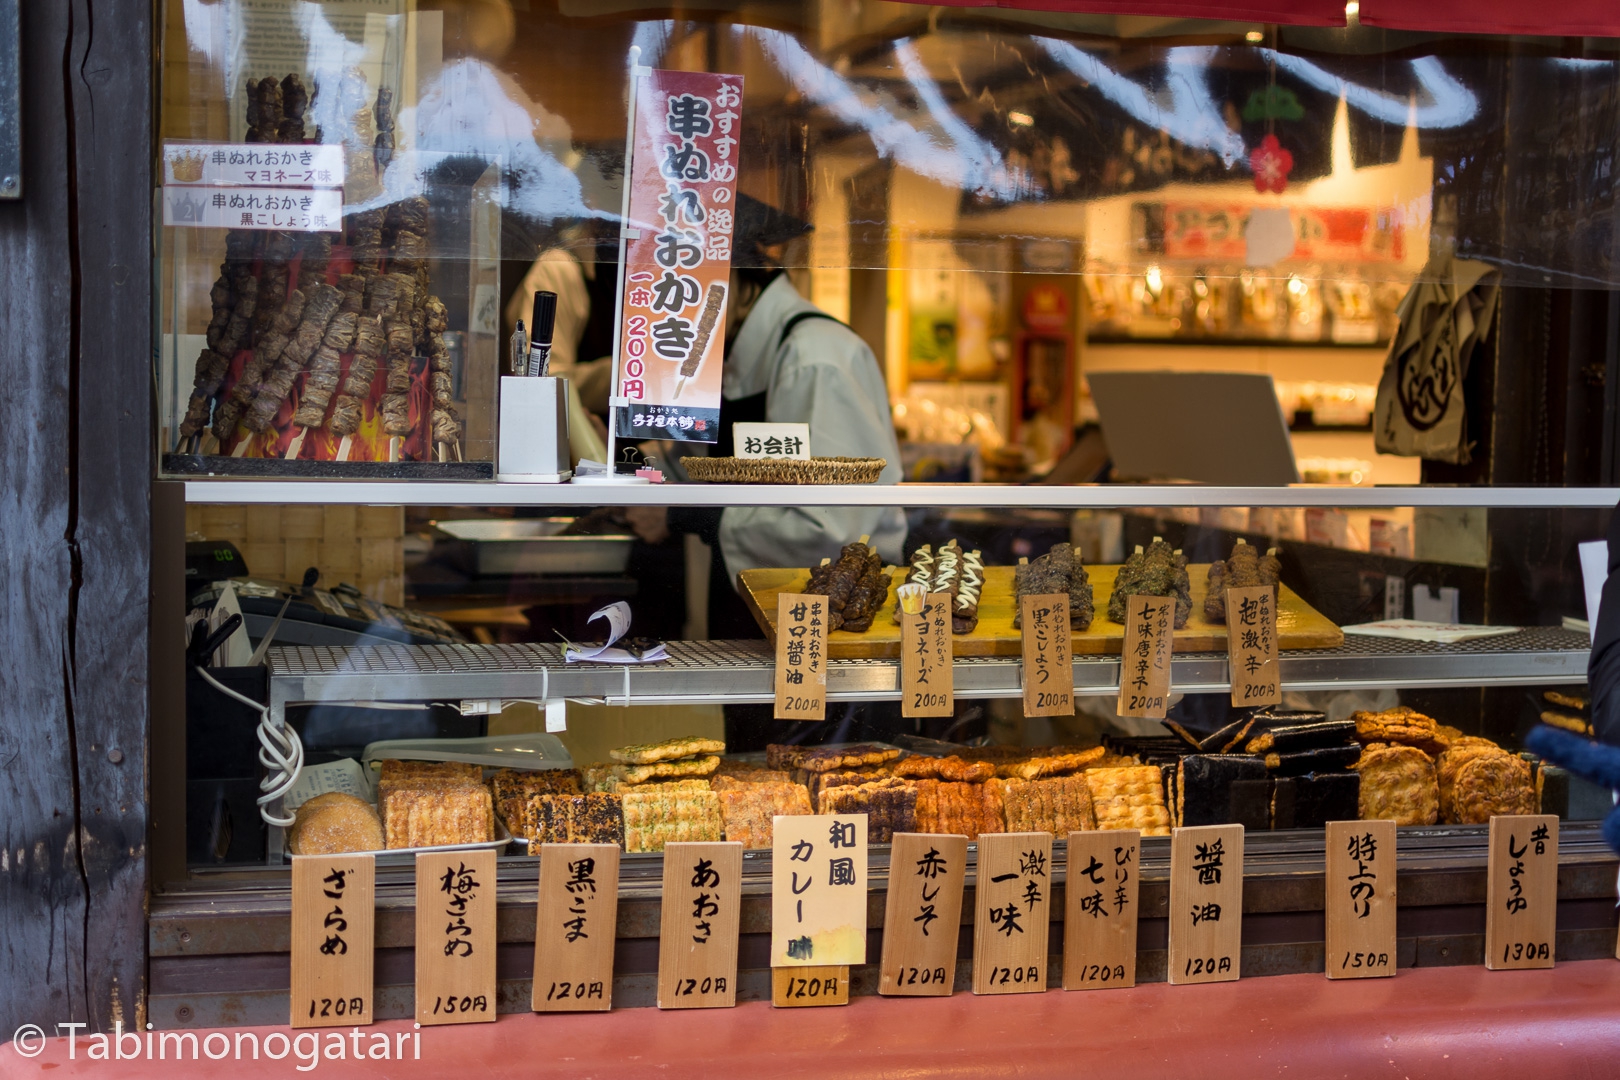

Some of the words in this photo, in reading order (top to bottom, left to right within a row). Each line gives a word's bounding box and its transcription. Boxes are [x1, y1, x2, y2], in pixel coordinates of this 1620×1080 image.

[212, 150, 313, 166] 串ぬれおかき
[244, 169, 332, 183] マヨネーズ味
[706, 82, 740, 260] おすすめの逸品
[212, 193, 313, 211] 串ぬれおかき
[240, 212, 328, 227] 黒こしょう味
[652, 95, 712, 358] 串ぬれおかき
[744, 436, 803, 455] お会計
[785, 602, 808, 685] 甘口醤油
[808, 601, 822, 673] 串ぬれおかき
[934, 602, 947, 667] 串ぬれおかき
[1032, 608, 1051, 684] 黒こしょう
[1052, 603, 1066, 667] 串ぬれおかき
[1132, 602, 1156, 690] 七味唐辛子
[1154, 604, 1170, 669] 串ぬれおかき
[1238, 597, 1262, 675] 超激辛
[1259, 594, 1272, 655] 串ぬれおかき
[784, 696, 820, 711] 200円
[914, 693, 947, 709] 200円
[1036, 692, 1069, 708] 200円
[1129, 695, 1163, 710] 200円
[1244, 683, 1275, 699] 200円
[828, 820, 856, 886] 和風
[1530, 823, 1550, 855] 昔
[563, 857, 597, 943] 黒ごま
[691, 857, 720, 944] あおさ
[914, 847, 947, 936] 赤しそ
[989, 872, 1024, 937] 一味
[1018, 849, 1046, 912] 激辛
[1080, 855, 1109, 918] 七味
[1190, 838, 1225, 927] 醤油
[1347, 832, 1377, 919] 特上のり
[1506, 834, 1528, 915] しょうゆ
[320, 867, 354, 956] ざらめ
[440, 862, 480, 957] 梅ざらめ
[897, 967, 946, 986] 120円
[990, 966, 1038, 985] 120円
[1080, 964, 1125, 981] 120円
[1185, 956, 1231, 976] 120円
[1342, 951, 1388, 969] 150円
[1503, 942, 1550, 962] 130円
[309, 998, 364, 1018] 120円
[433, 995, 487, 1015] 150円
[547, 981, 603, 1001] 120円
[675, 977, 727, 996] 120円
[786, 977, 837, 998] 120円
